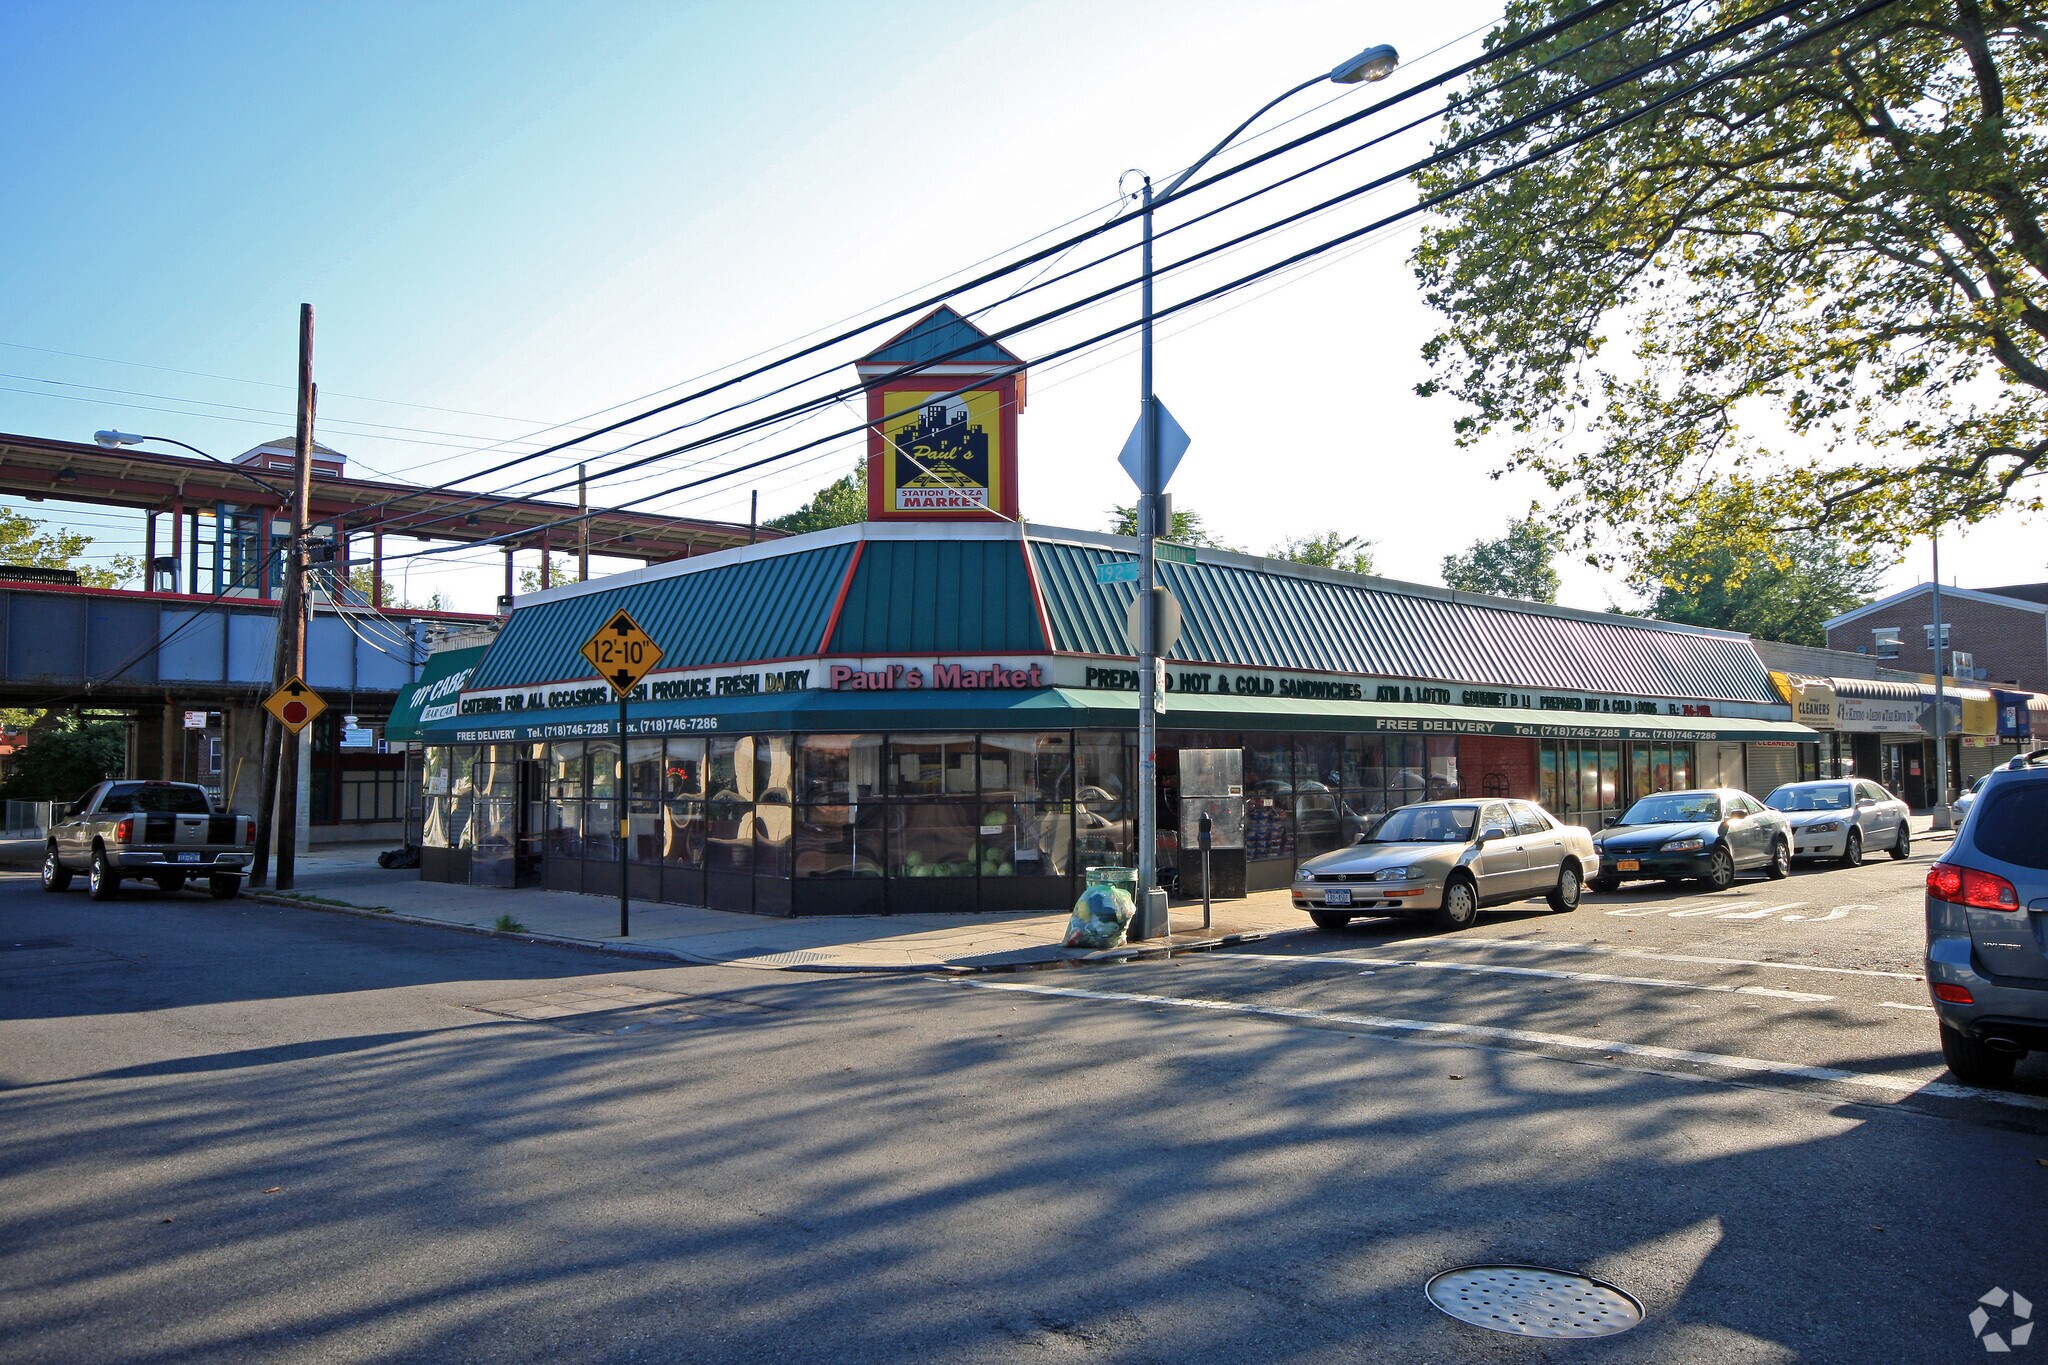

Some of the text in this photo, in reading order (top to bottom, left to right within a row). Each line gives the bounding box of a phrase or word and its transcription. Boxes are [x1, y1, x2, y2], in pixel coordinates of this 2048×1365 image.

[912, 445, 974, 460] Paul's
[904, 497, 981, 507] MARKET
[1101, 566, 1123, 581] 192
[830, 663, 1042, 691] Paul's Market
[461, 697, 502, 714] CATERING
[505, 694, 523, 711] FOR
[526, 692, 545, 709] ALL
[548, 687, 607, 706] OCCASIONS
[652, 678, 711, 699] PRODUCE
[716, 674, 760, 695] FRESH
[1086, 667, 1174, 692] PREPAD
[1179, 673, 1211, 692] HOT
[1218, 674, 1230, 692] &
[1235, 675, 1274, 696] COLD
[1279, 678, 1362, 700] SANDWICHES
[1376, 685, 1400, 702] ATM
[1403, 686, 1413, 703] &
[1417, 687, 1451, 704] LOTTO
[1585, 697, 1600, 712] HOT
[1603, 699, 1610, 712] &
[1612, 700, 1632, 713] COLD
[425, 705, 454, 719] BAR CAR
[1798, 702, 1830, 716] CLEANERS
[457, 731, 476, 741] FREE
[478, 729, 516, 741] DELIVERY
[527, 728, 543, 738] Tel.
[545, 723, 608, 738] (718)746-7285
[640, 717, 718, 733] (718)746-7286
[1376, 719, 1717, 740] FREE DELIVERY Tel. (718)746-7285 Fax. (718)746-7286
